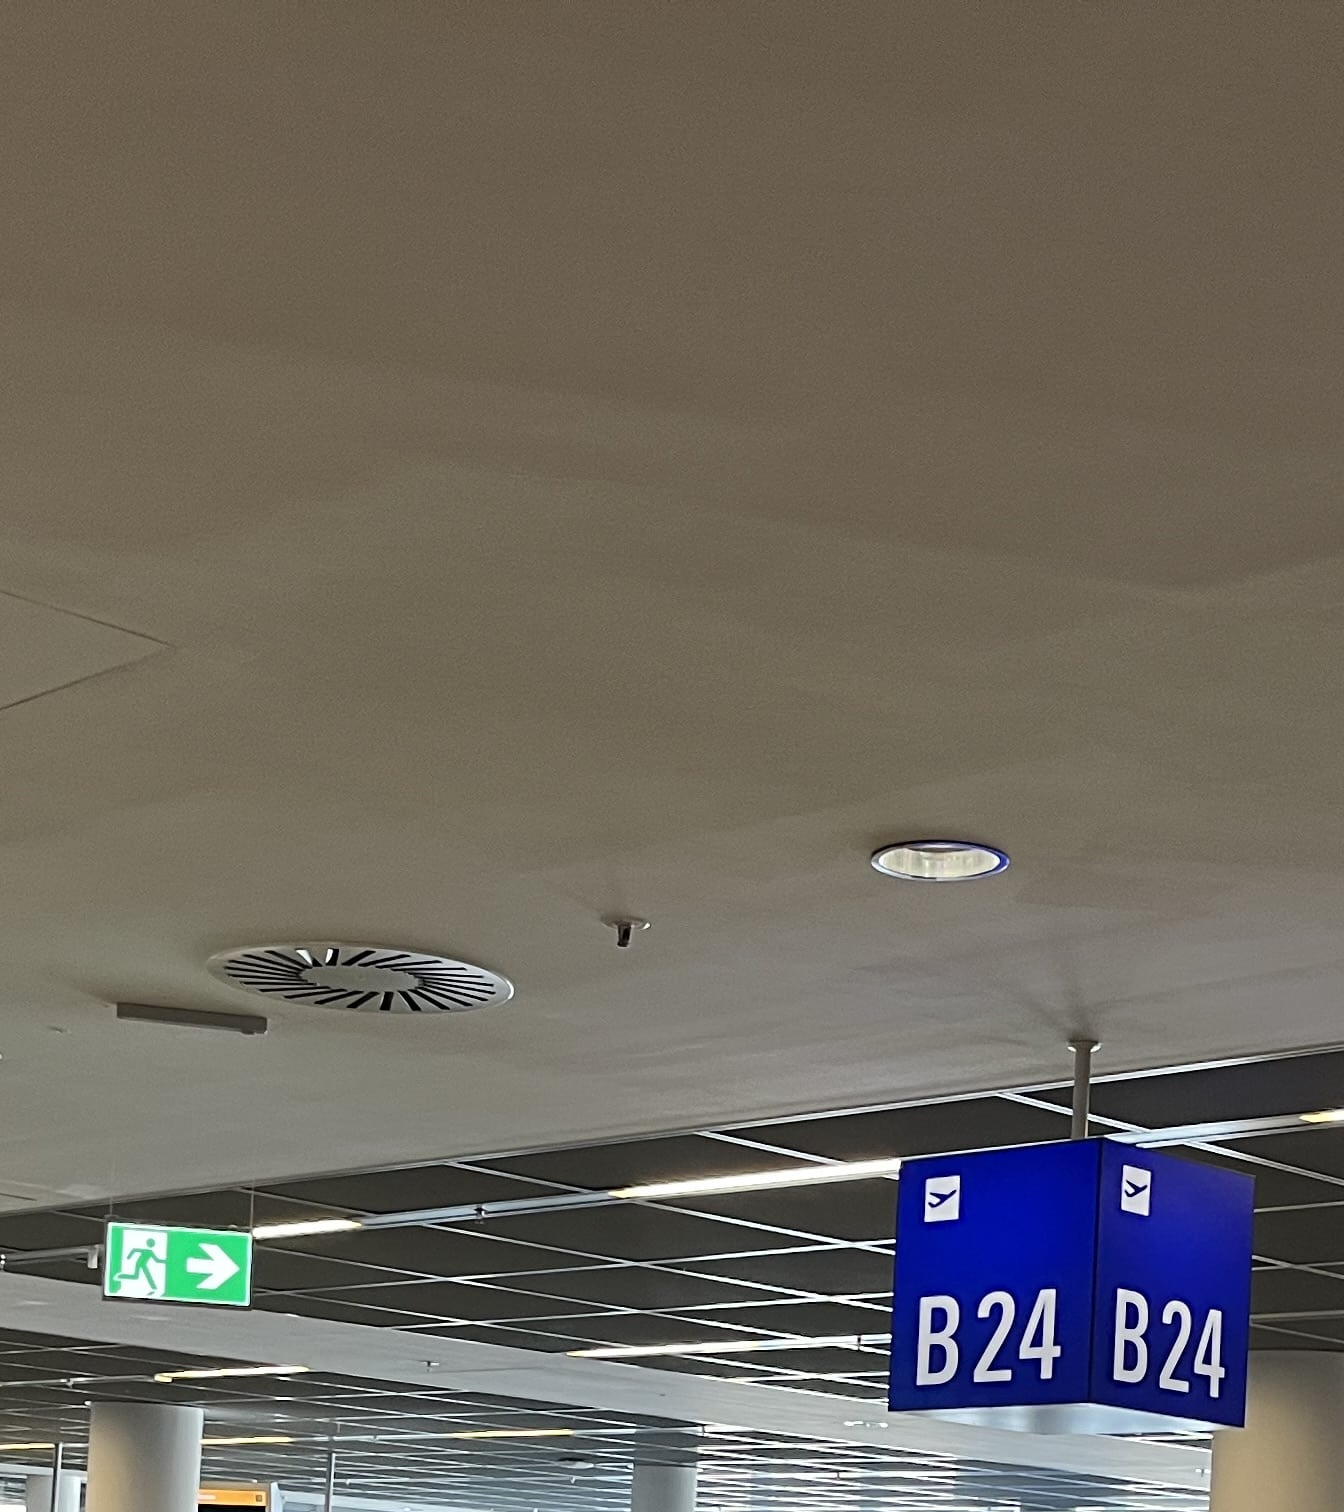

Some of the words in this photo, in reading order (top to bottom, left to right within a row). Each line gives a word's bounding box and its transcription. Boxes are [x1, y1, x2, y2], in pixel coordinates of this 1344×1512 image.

[916, 1294, 960, 1387] B
[973, 1288, 1062, 1384] 24
[1113, 1287, 1149, 1384] B
[1159, 1299, 1225, 1399] 24
